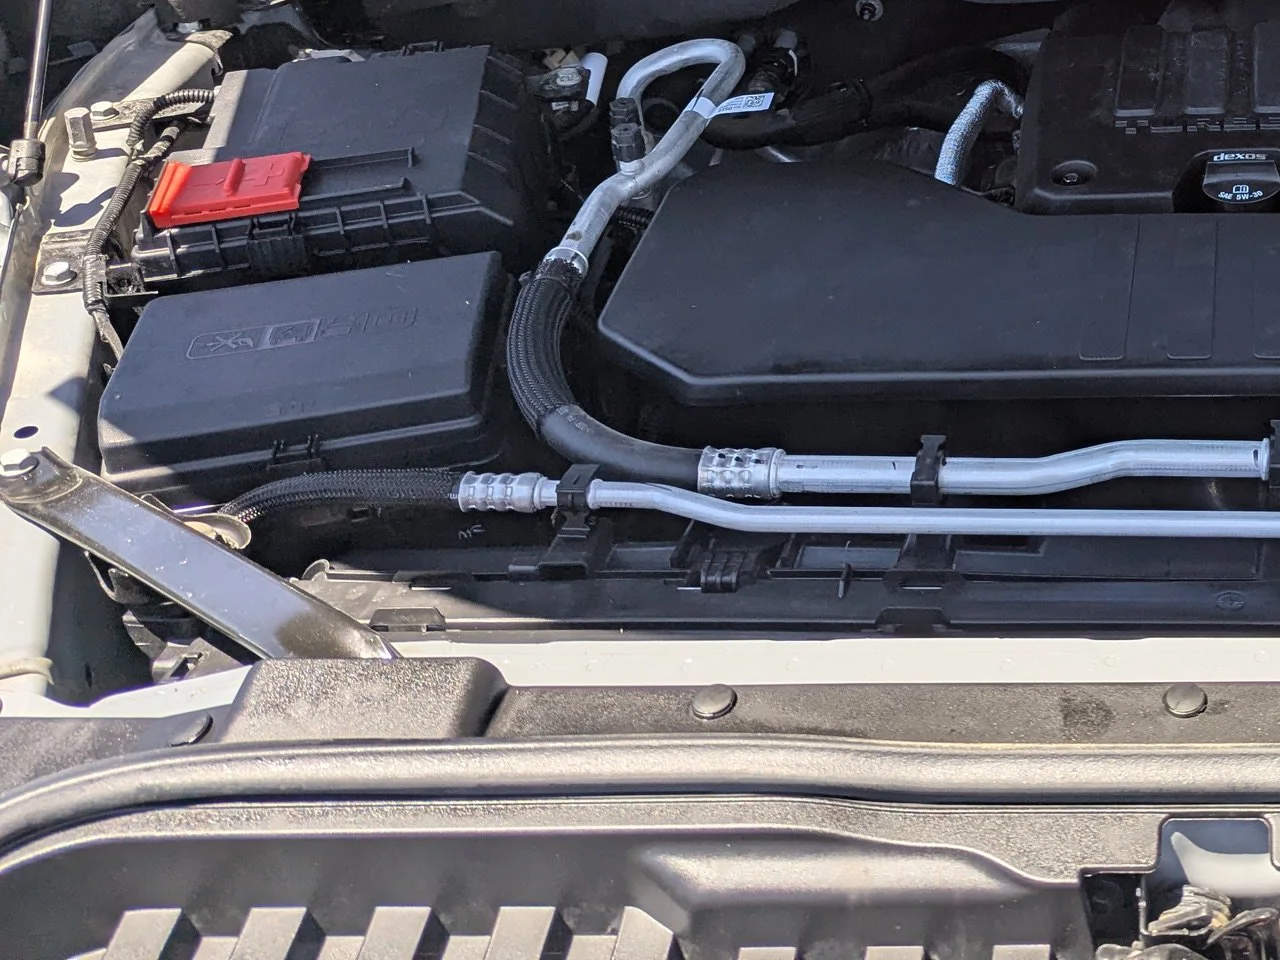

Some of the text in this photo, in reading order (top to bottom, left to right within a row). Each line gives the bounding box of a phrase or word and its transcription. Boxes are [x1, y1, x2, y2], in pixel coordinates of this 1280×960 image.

[1212, 152, 1267, 162] dexos
[1217, 190, 1264, 201] SAE 5W-30
